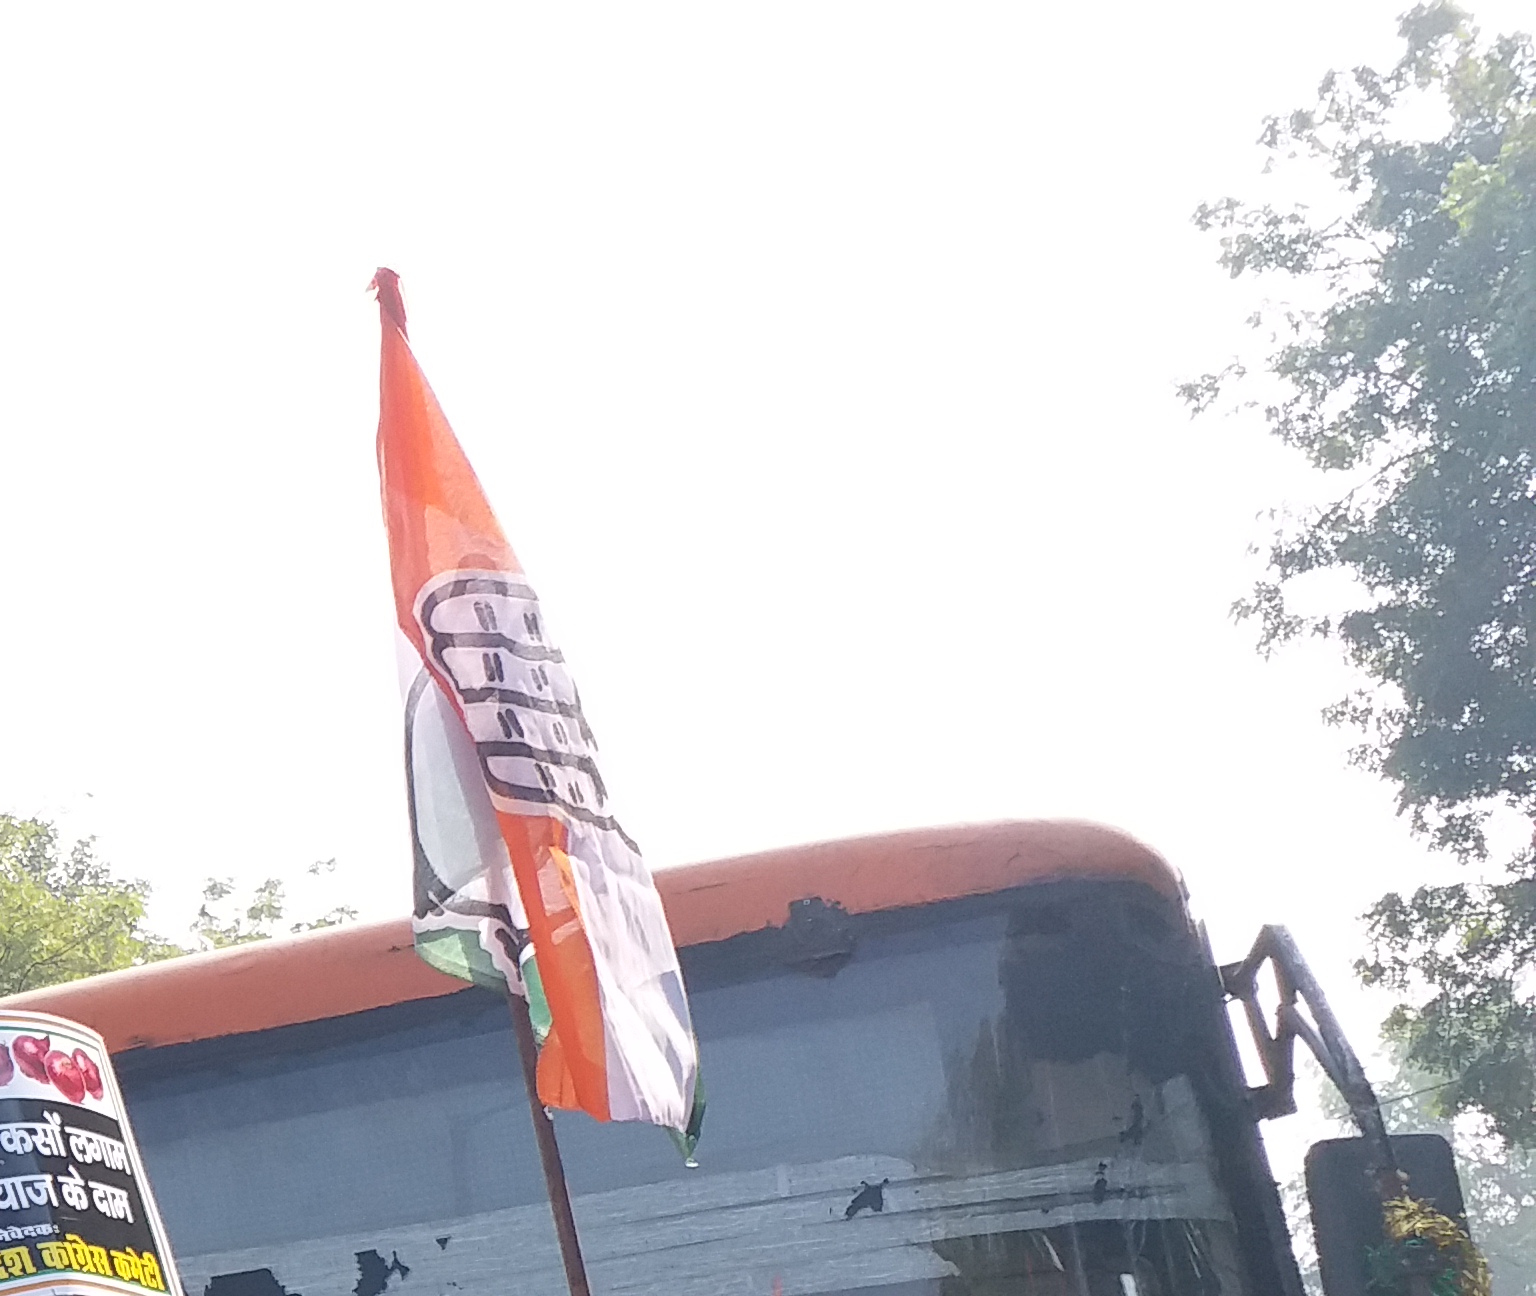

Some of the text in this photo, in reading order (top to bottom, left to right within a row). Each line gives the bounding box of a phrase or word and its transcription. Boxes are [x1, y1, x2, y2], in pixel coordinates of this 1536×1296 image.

[65, 1127, 131, 1175] लगाम
[57, 1164, 90, 1211] के
[87, 1180, 135, 1224] दाम
[109, 1247, 165, 1291] कमेटी
